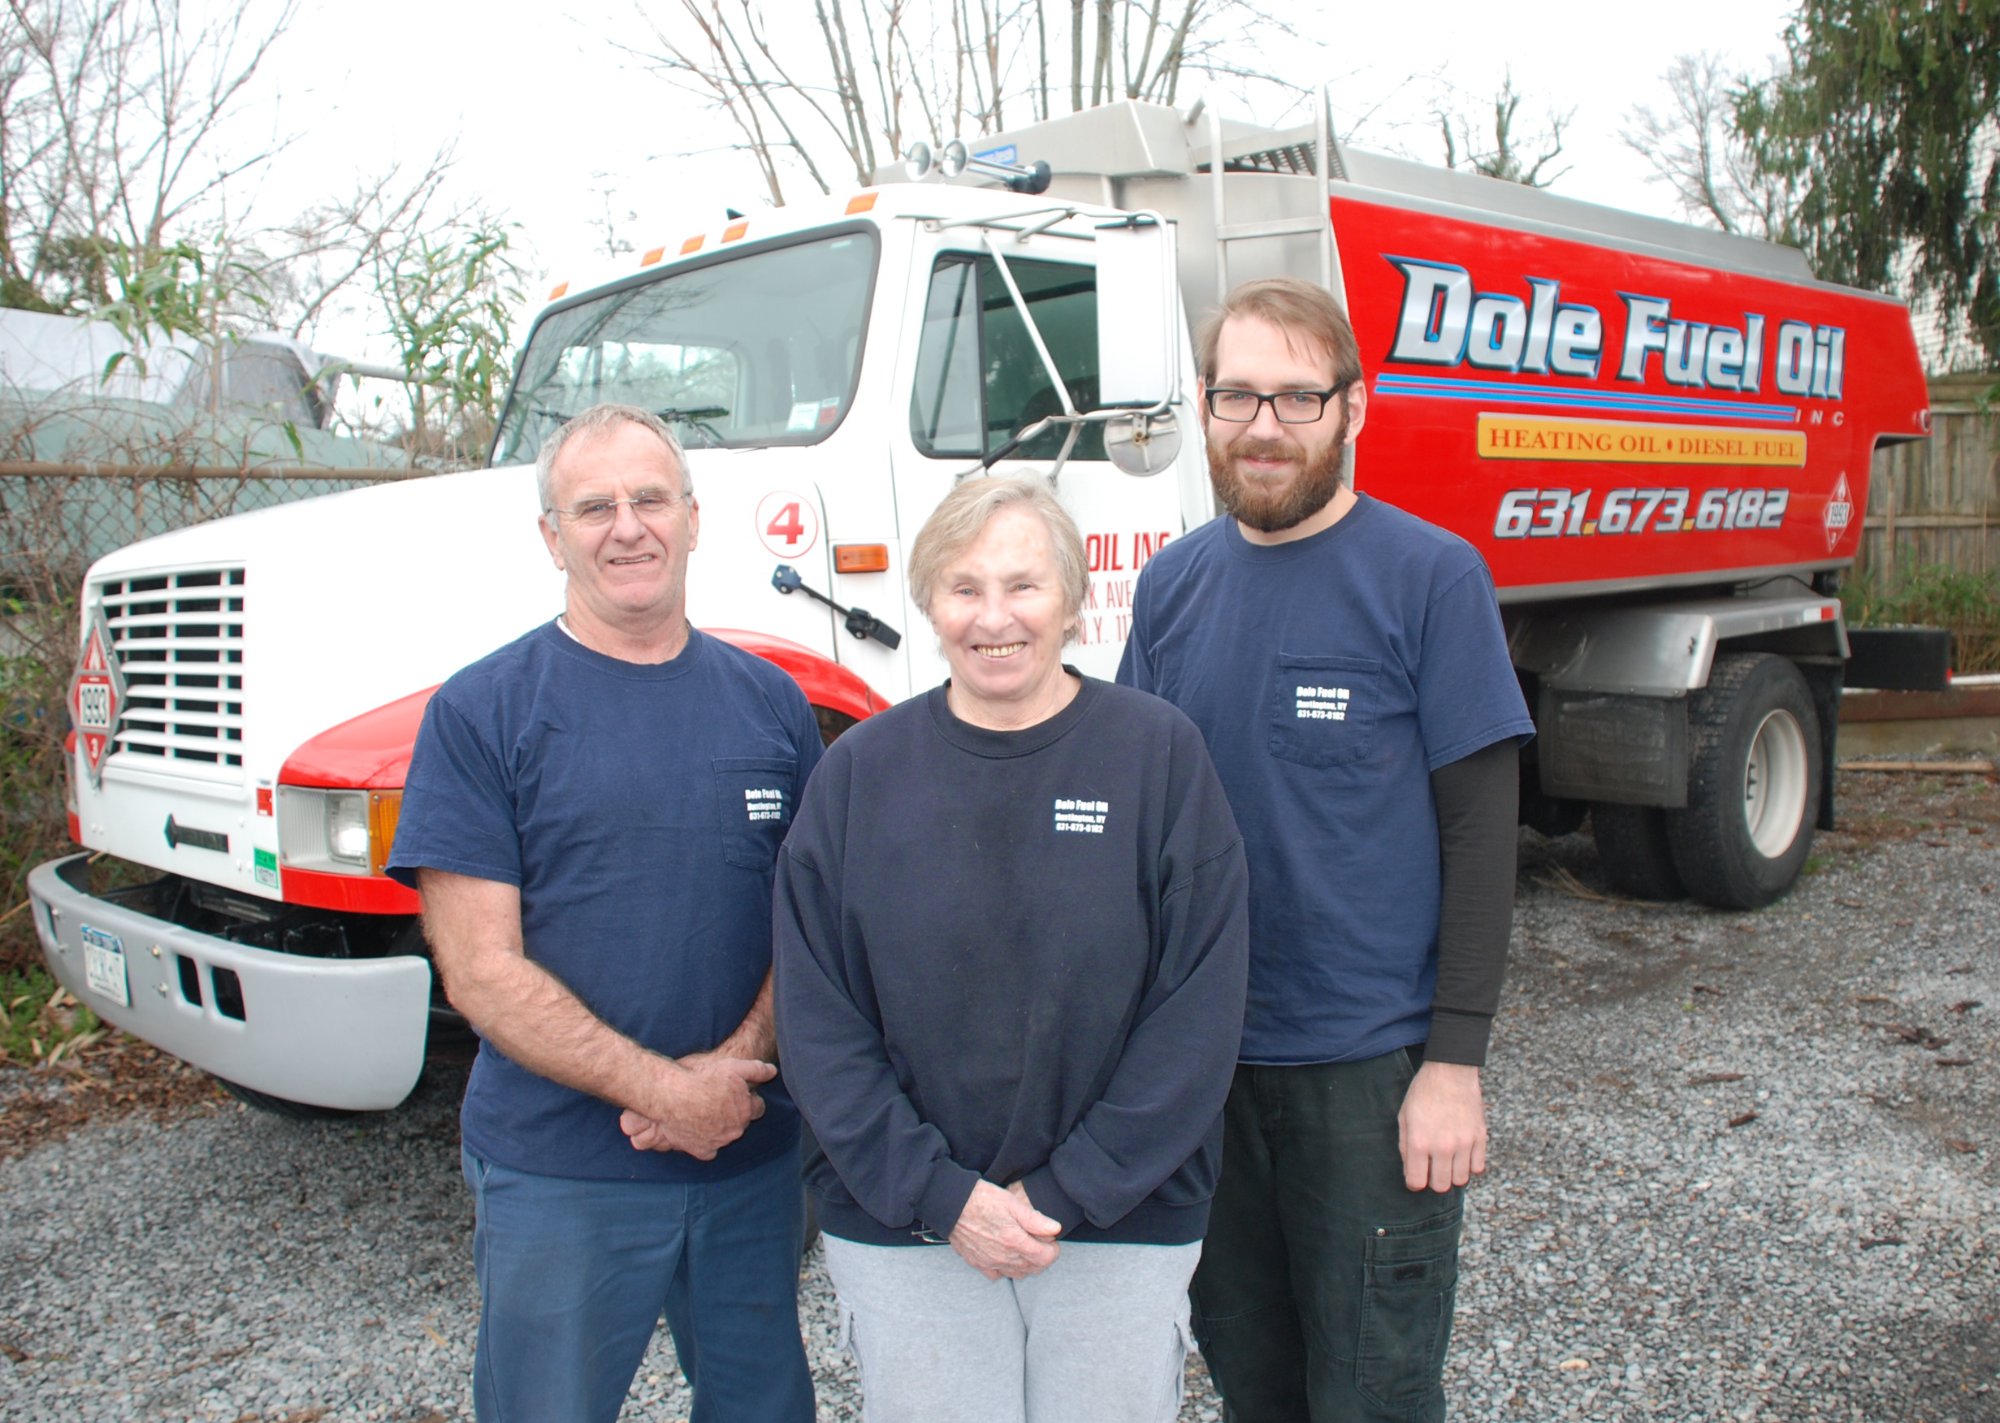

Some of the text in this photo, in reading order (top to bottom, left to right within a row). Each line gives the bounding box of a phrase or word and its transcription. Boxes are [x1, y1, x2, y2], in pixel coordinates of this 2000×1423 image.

[1379, 253, 1846, 401] Dole Fuel Oil
[1795, 408, 1845, 426] INC
[1490, 428, 1800, 458] HEATING OIL DIESEL FUEL
[766, 502, 804, 545] 4
[1494, 488, 1790, 539] 631.673.6182
[1086, 533, 1123, 572] OIL
